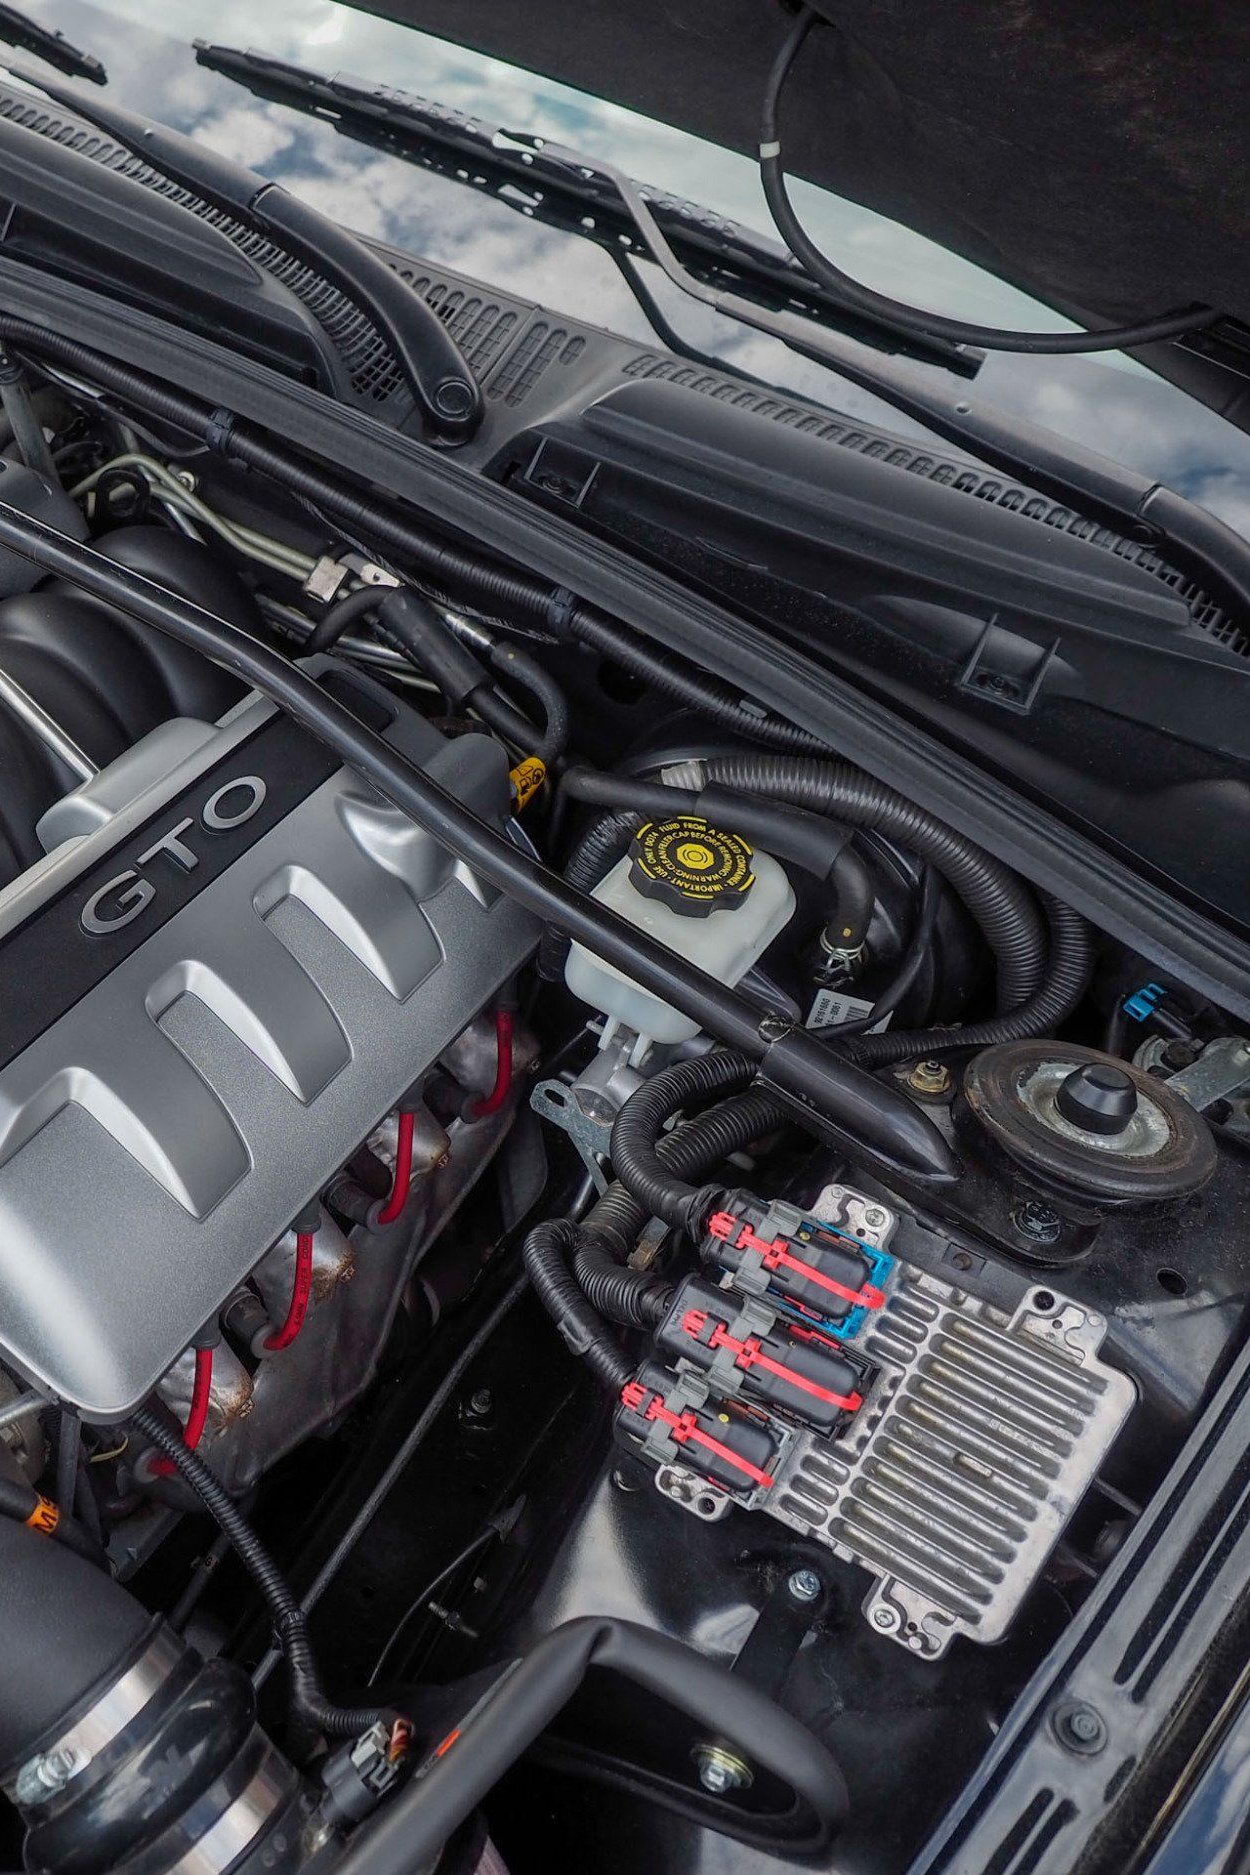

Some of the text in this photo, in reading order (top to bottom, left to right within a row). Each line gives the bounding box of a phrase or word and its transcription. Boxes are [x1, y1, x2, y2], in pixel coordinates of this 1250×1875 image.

[658, 822, 681, 833] FLUID
[683, 822, 707, 832] FROM
[716, 833, 742, 855] SEALED
[672, 831, 690, 839] CAP
[690, 831, 722, 848] BEFORE
[81, 775, 267, 936] GTO
[669, 878, 725, 893] IMPORTANT
